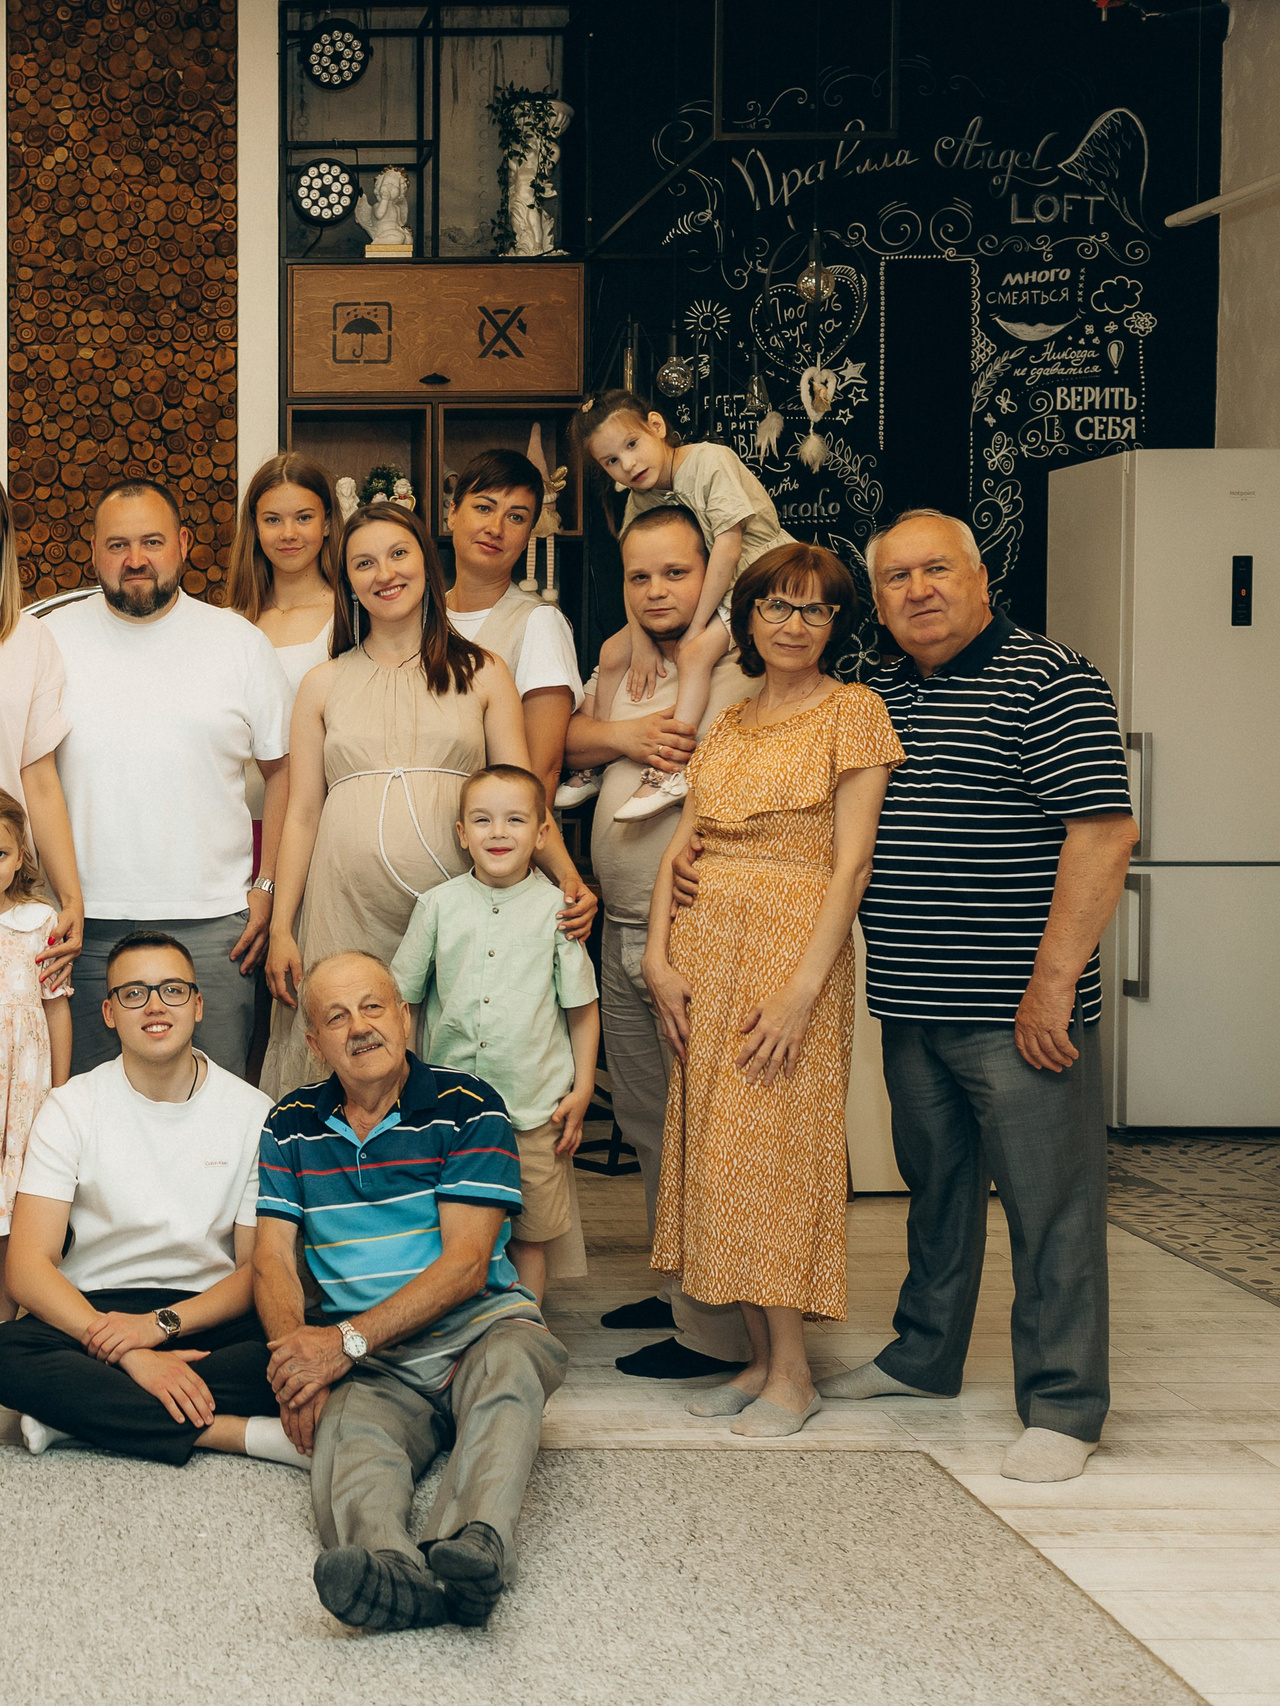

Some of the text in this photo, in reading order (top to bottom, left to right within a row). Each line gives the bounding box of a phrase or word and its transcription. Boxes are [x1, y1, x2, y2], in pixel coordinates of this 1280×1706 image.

[934, 115, 1061, 198] Angel
[1010, 192, 1106, 225] LOFT
[985, 288, 1070, 306] СМЕЯТЬСЯ
[1028, 340, 1100, 366] Никогда
[1013, 365, 1103, 386] не сдаваться
[1055, 386, 1138, 413] ВЕРИТЬ
[1075, 417, 1137, 442] СЕБЯ
[777, 487, 841, 519] ысоко
